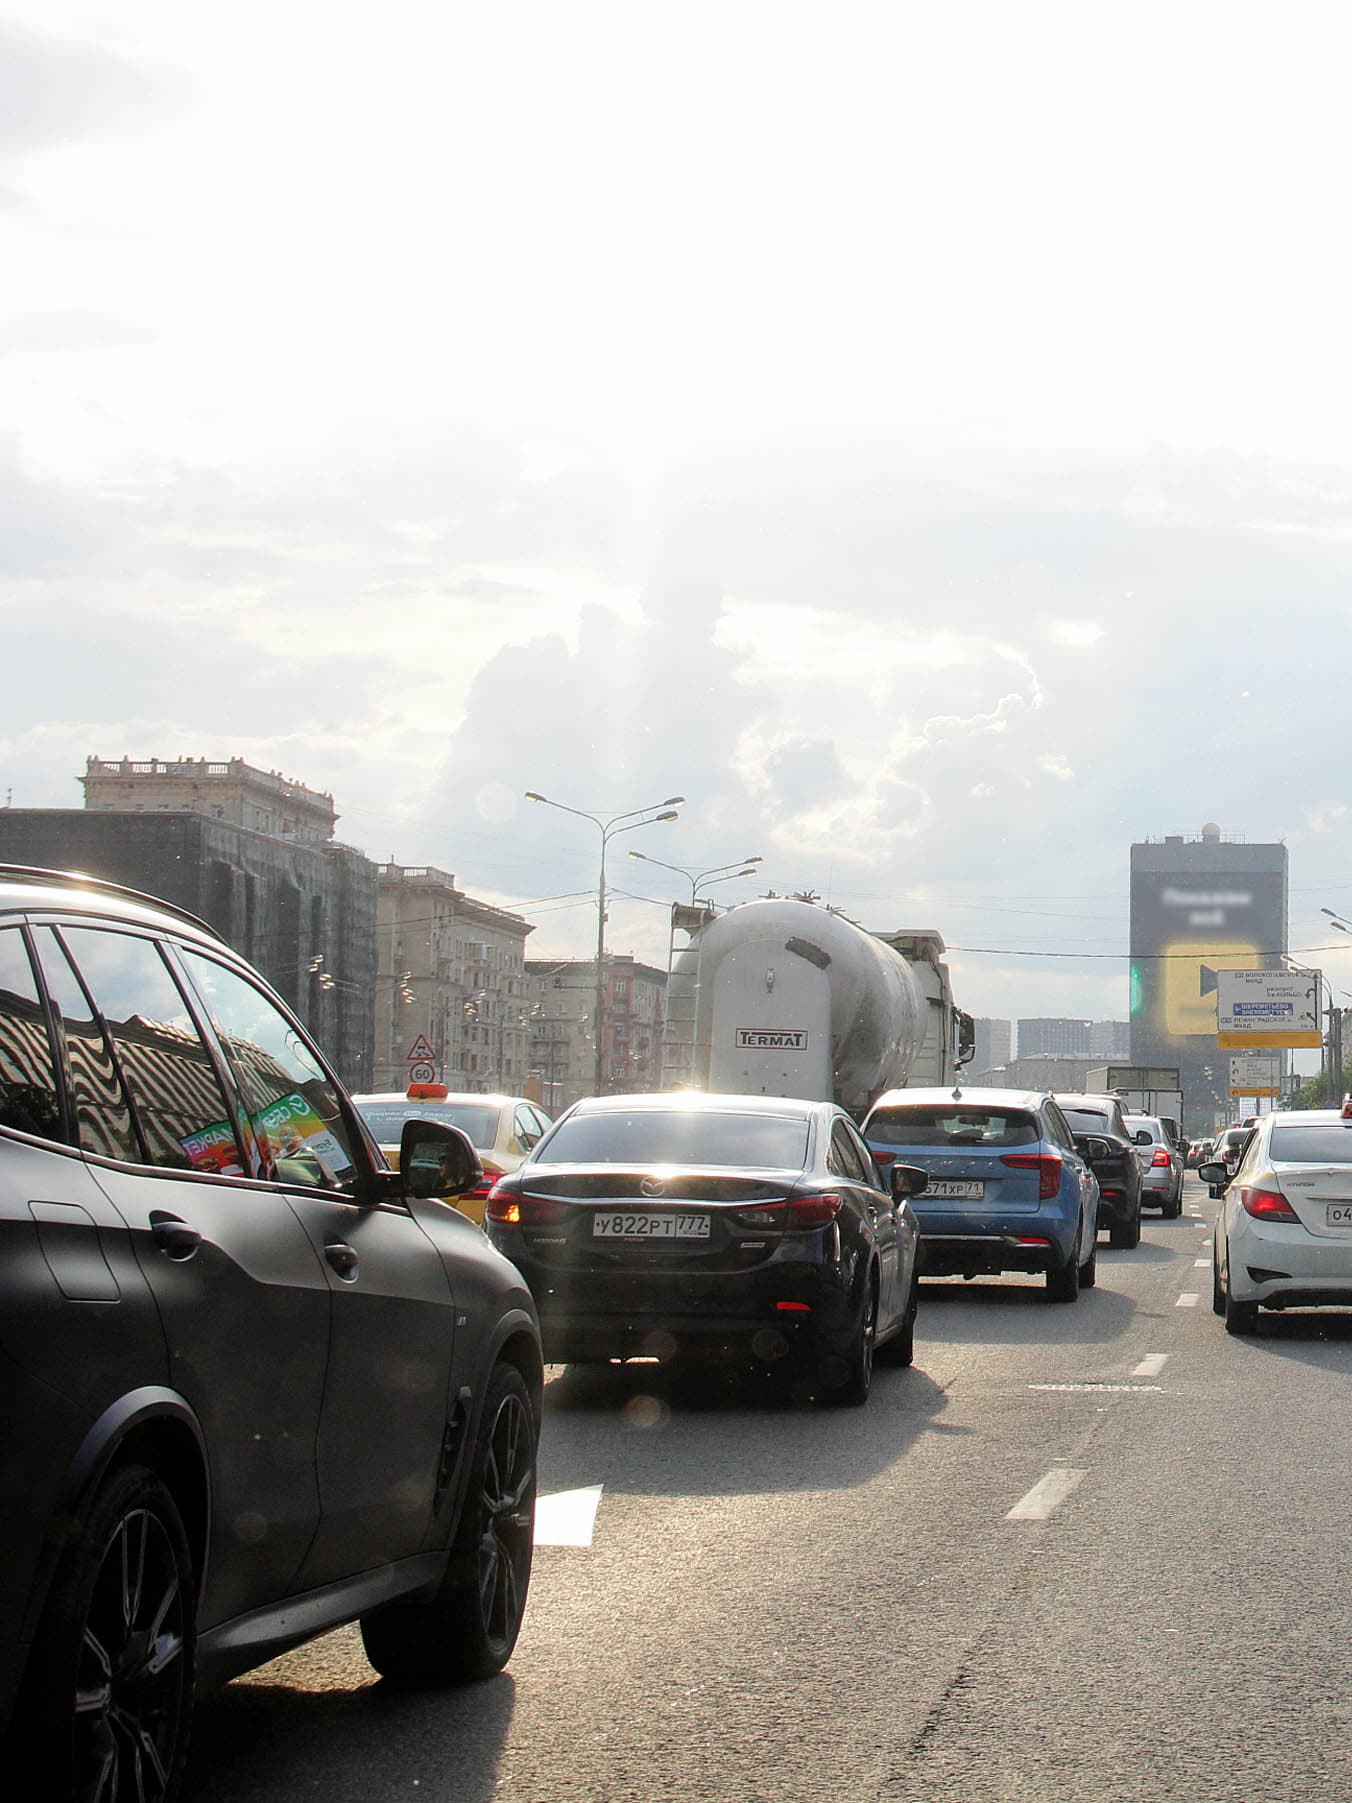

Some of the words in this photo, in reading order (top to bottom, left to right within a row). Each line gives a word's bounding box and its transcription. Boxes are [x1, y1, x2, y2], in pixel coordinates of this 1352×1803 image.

[740, 1031, 803, 1047] TERMAT
[415, 1069, 430, 1080] 60
[677, 1215, 705, 1231] 777
